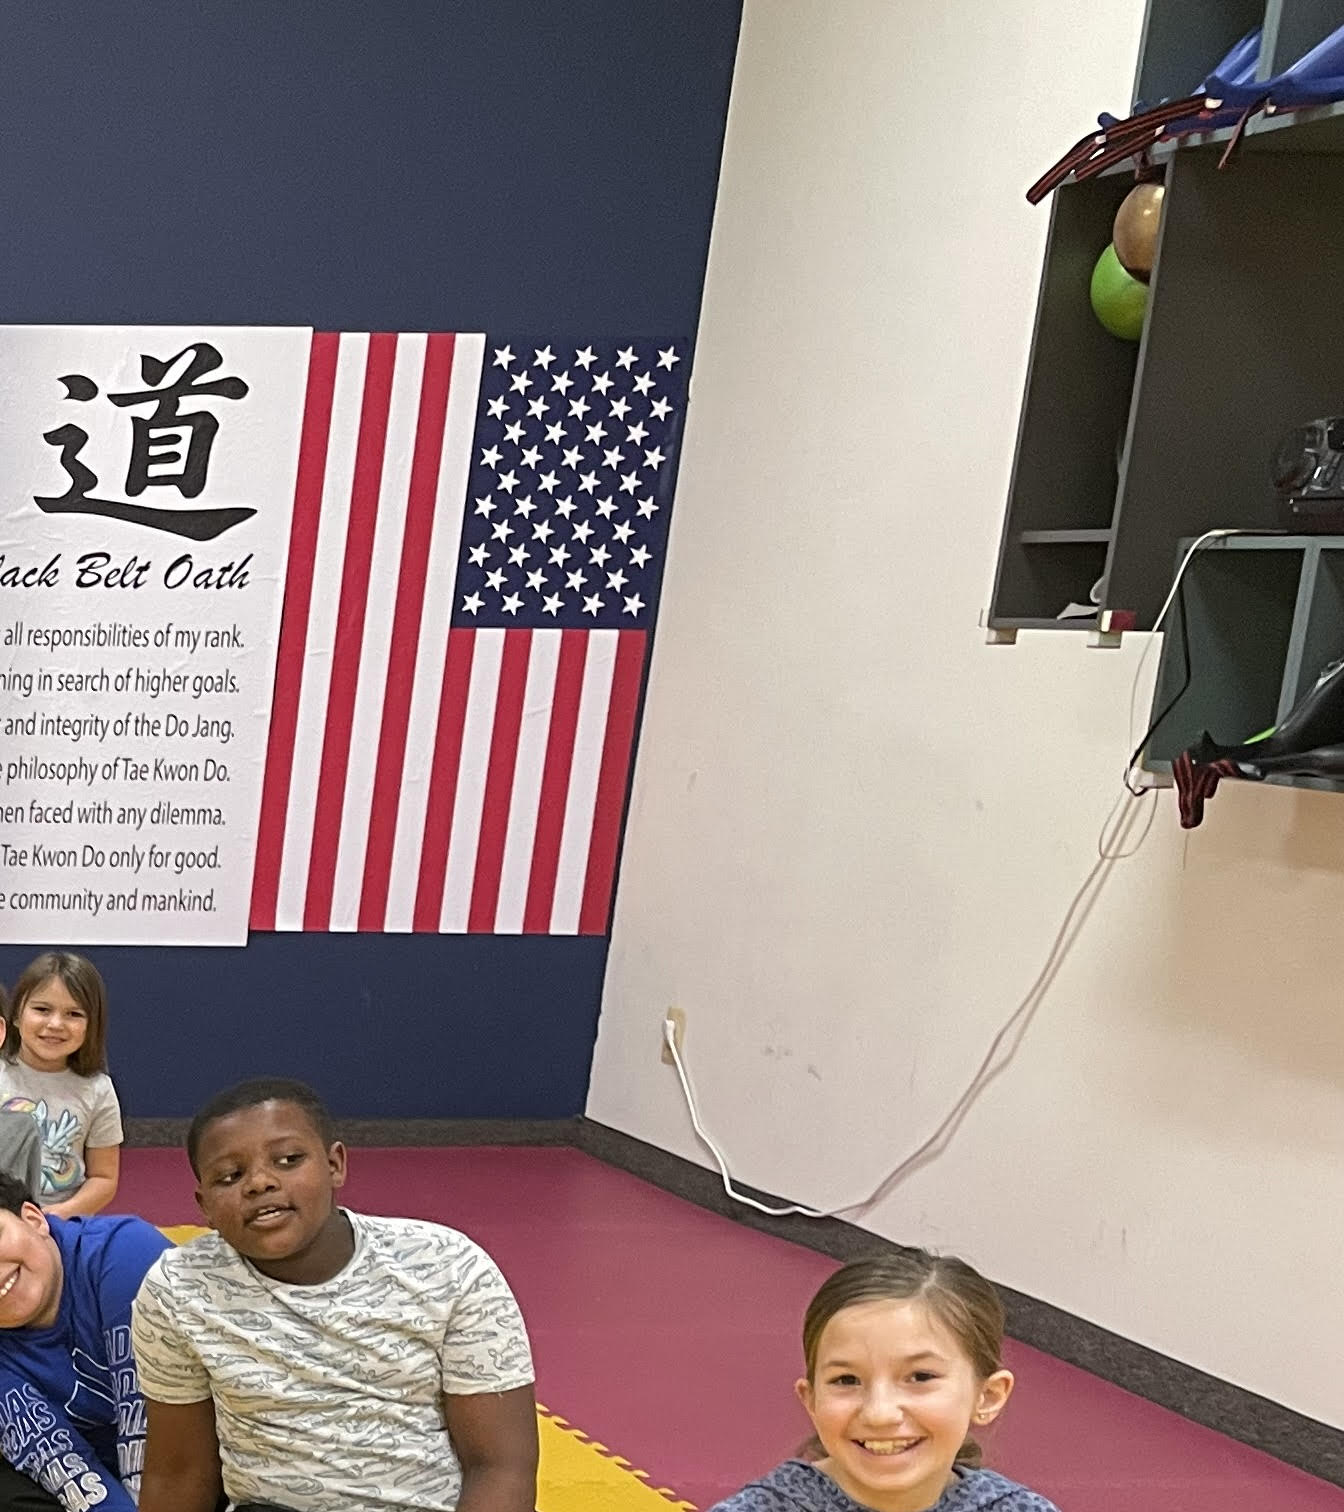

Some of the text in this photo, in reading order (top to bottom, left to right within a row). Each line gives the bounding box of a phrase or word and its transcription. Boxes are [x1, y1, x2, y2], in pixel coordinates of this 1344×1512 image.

[33, 342, 258, 541] 道
[75, 551, 152, 589] Belt
[163, 552, 254, 590] Oath
[5, 623, 23, 646] all
[27, 623, 150, 653] responsibilities
[153, 623, 173, 648] of
[175, 630, 201, 654] my
[204, 624, 245, 649] rank.
[37, 668, 52, 692] in
[57, 668, 110, 693] search
[114, 668, 133, 693] of
[136, 669, 190, 698] higher
[192, 669, 240, 698] goals.
[5, 712, 36, 737] and
[40, 712, 110, 743] integrity
[113, 713, 133, 738] of
[134, 713, 161, 738] the
[166, 714, 189, 738] Do
[192, 714, 235, 744] Jang.
[6, 756, 99, 786] philosophy
[101, 757, 121, 782] of
[122, 758, 149, 782] Tae
[153, 758, 199, 782] Kwon
[203, 758, 231, 782] Do.
[28, 800, 72, 824] faced
[76, 800, 113, 825] with
[117, 808, 147, 831] any
[150, 801, 227, 827] dilemma.
[0, 844, 28, 868] Tae
[32, 844, 78, 868] Kwon
[82, 845, 106, 868] Do
[110, 845, 144, 873] only
[148, 845, 172, 869] for
[174, 846, 222, 874] good.
[10, 887, 102, 916] community
[106, 888, 137, 912] and
[141, 888, 217, 913] mankind.
